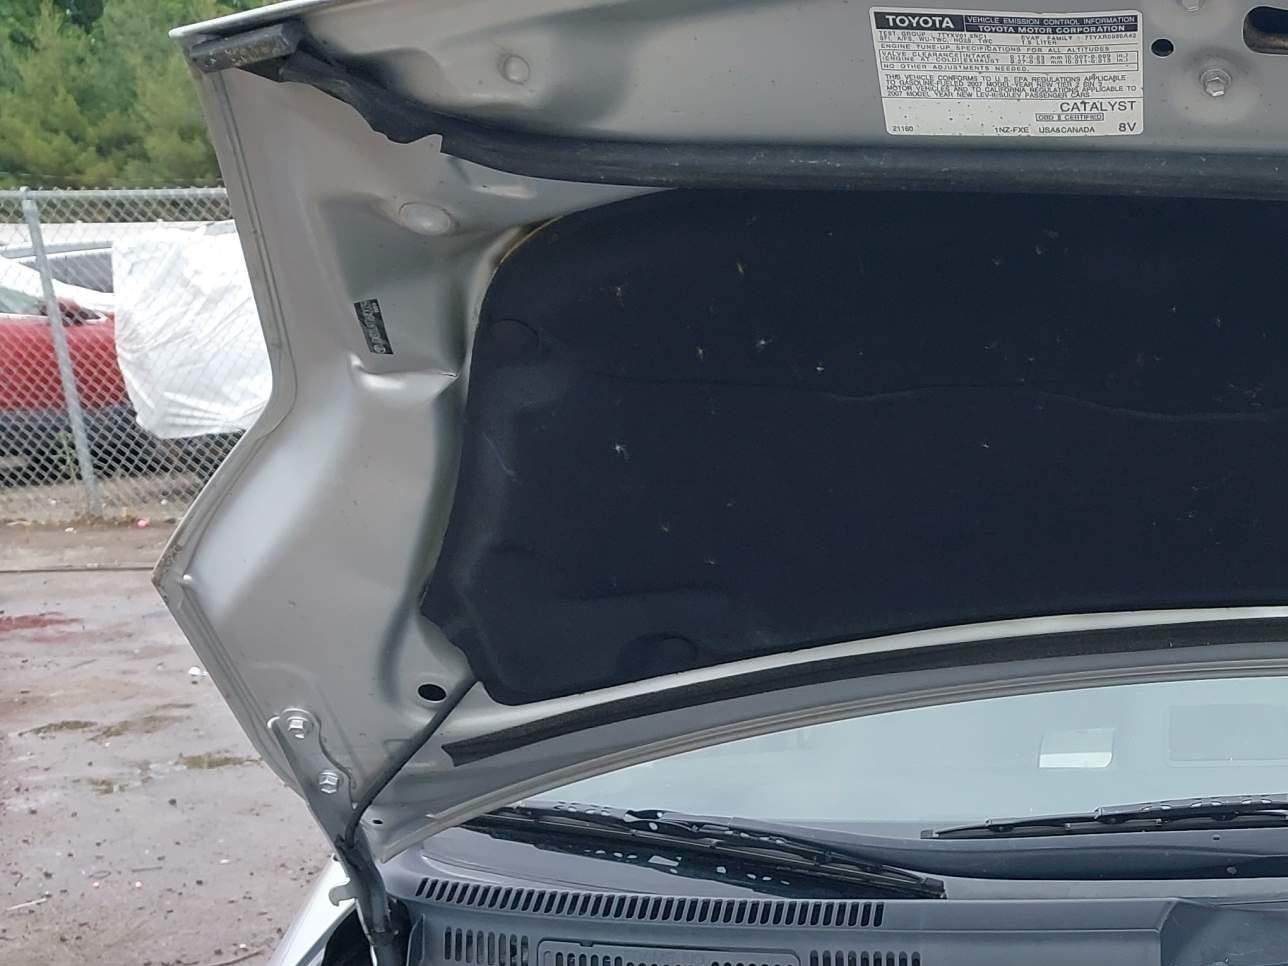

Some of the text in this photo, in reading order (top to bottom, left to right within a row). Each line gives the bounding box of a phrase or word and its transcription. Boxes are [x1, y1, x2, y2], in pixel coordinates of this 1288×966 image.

[885, 15, 955, 29] TOYOTA
[967, 16, 1135, 26] VEHICLE EMISSION CONTROL INFORMATION
[979, 25, 1125, 34] TOYOTA MOTOR CORPORATION
[1059, 100, 1137, 112] CATALYST
[994, 126, 1030, 134] 1NZ-FXE
[1038, 126, 1096, 134] USA&CANADA
[1117, 122, 1137, 133] 8V
